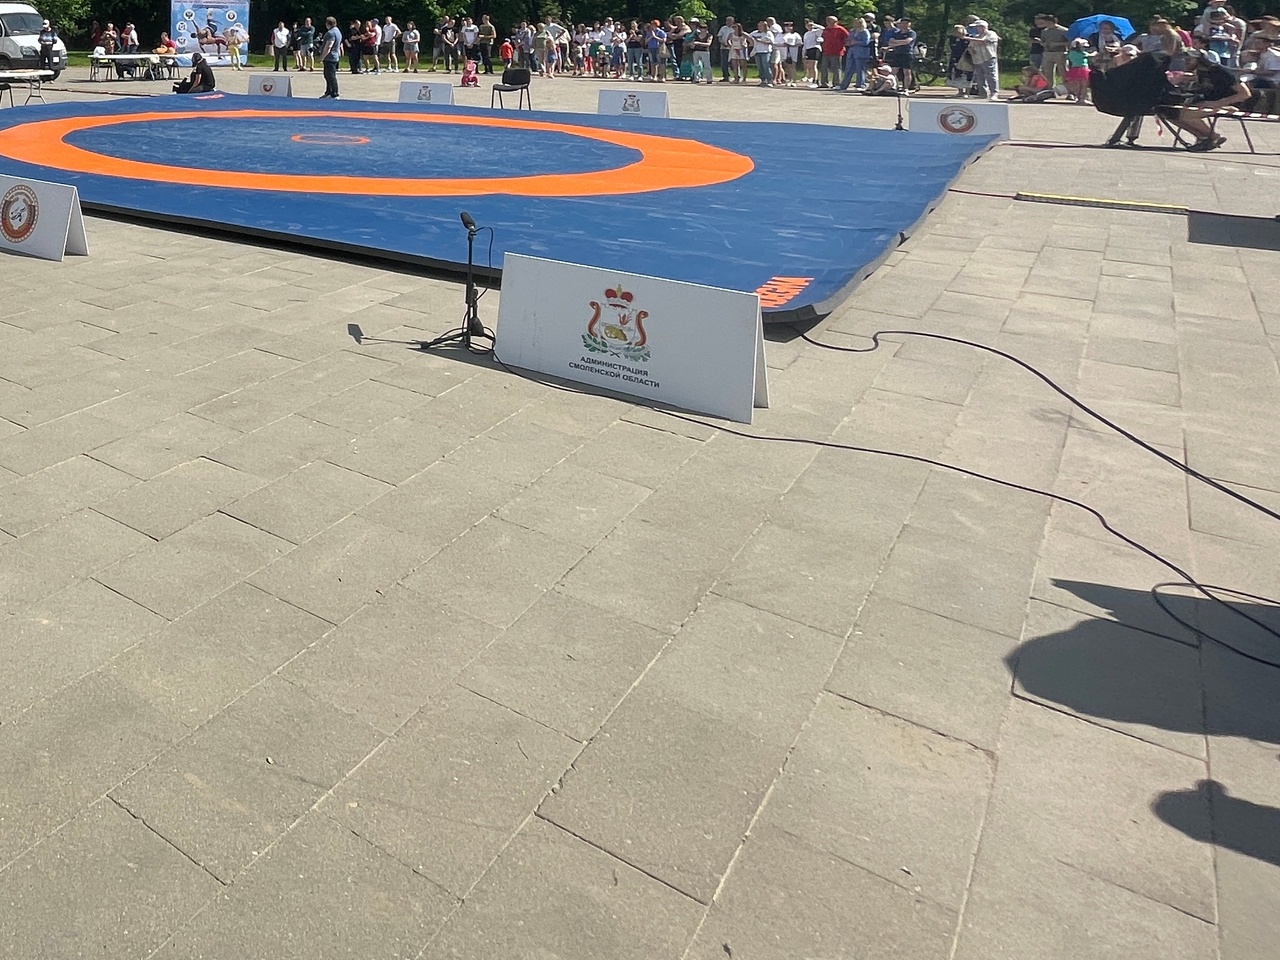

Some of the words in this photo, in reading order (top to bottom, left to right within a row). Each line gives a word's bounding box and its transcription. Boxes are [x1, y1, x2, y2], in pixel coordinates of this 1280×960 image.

[568, 361, 621, 380] СМОЛЕНСКОЙ
[622, 374, 660, 388] ОБЛАСТИ
[580, 356, 649, 377] АДМИНИСТРАЦИЯ
